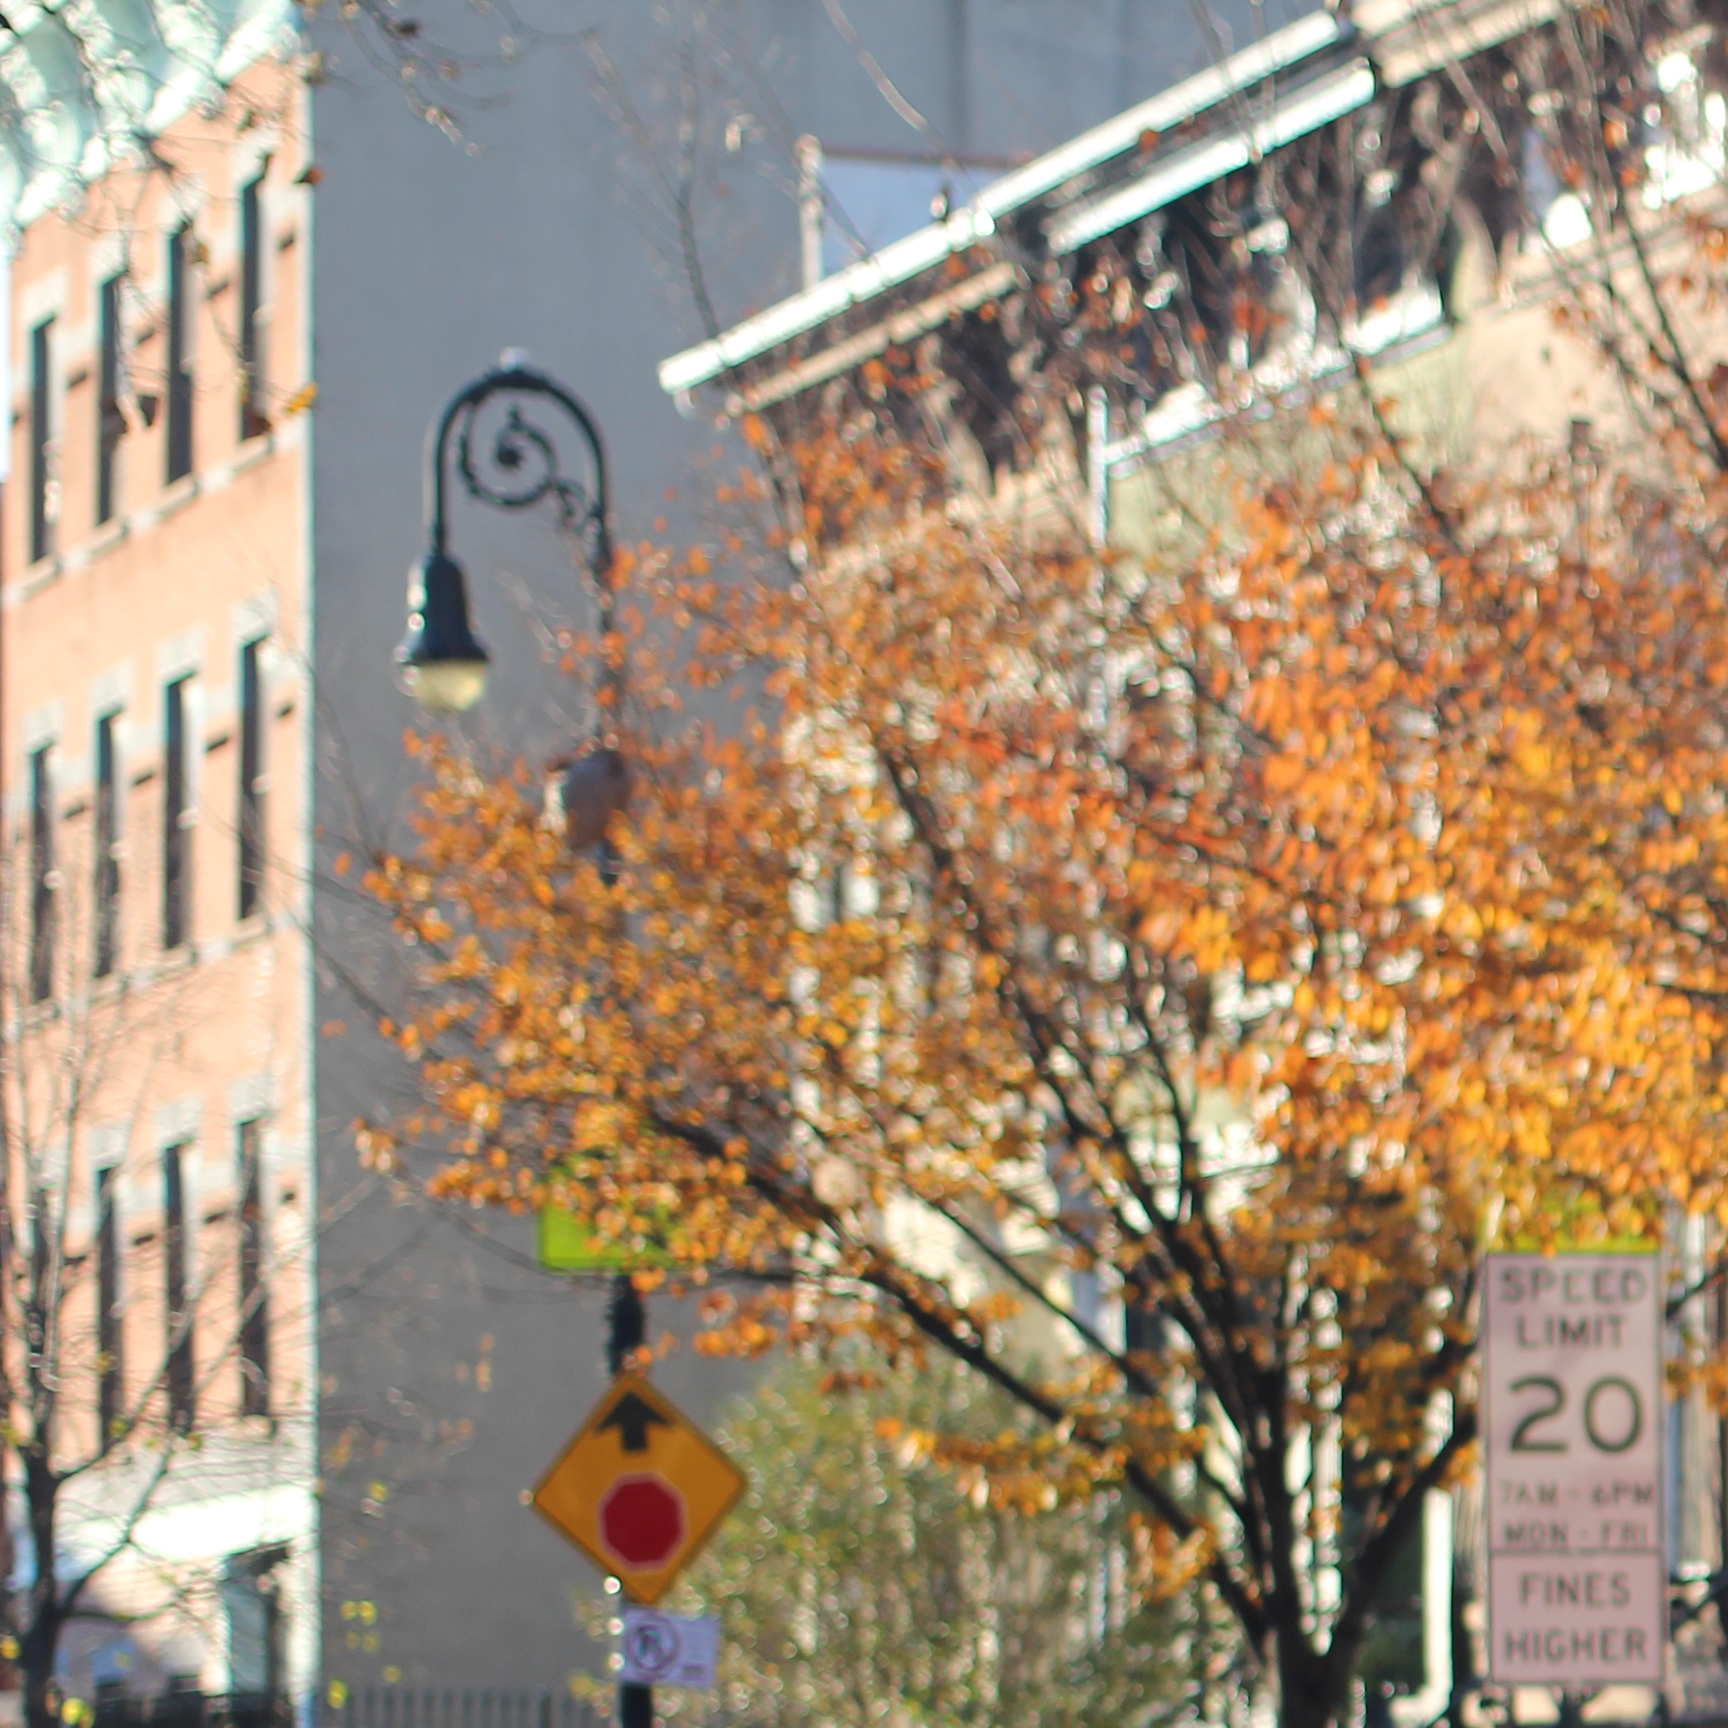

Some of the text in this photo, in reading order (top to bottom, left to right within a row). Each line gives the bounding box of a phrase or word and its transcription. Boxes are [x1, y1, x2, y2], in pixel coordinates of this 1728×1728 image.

[1501, 1267, 1647, 1303] SPEED
[1516, 1314, 1627, 1348] LIMIT
[1510, 1374, 1643, 1455] 20
[1500, 1481, 1558, 1505] 7AM
[1504, 1521, 1568, 1546] MON
[1602, 1520, 1648, 1546] FRI
[1520, 1572, 1630, 1607] FINES
[1505, 1627, 1647, 1663] HIGHER
